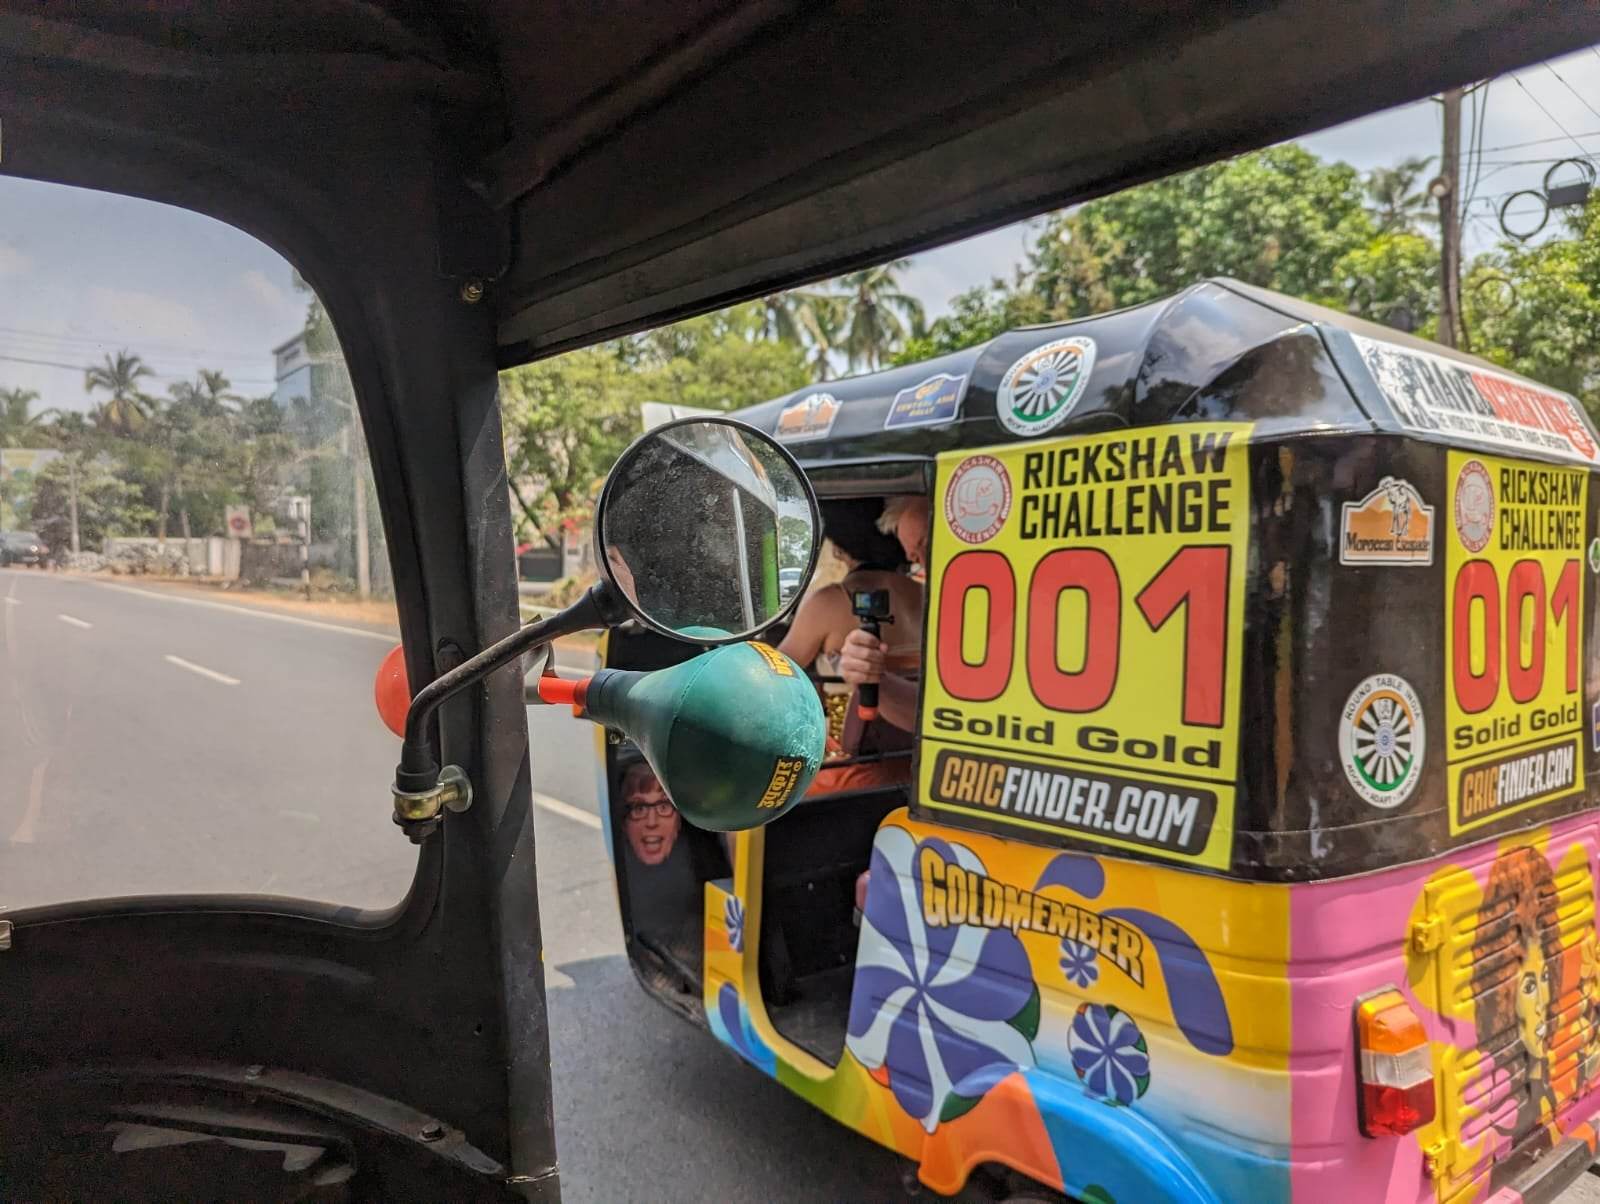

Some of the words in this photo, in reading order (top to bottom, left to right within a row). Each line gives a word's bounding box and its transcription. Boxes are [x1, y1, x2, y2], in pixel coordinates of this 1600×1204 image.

[1023, 432, 1234, 490] RICKSHAW
[1500, 468, 1584, 506] RICKSHAW
[1020, 479, 1232, 540] CHALLENGE
[1500, 508, 1581, 551] CHALLENGE
[936, 544, 1231, 728] 001
[1452, 558, 1580, 715] 001
[1344, 683, 1372, 721] ROUND
[1376, 677, 1402, 690] TABLE
[1454, 712, 1521, 750] Solid
[1530, 702, 1578, 731] Gold
[933, 707, 1055, 745] Solid
[1077, 726, 1221, 769] Gold
[939, 756, 1200, 847] CRICFINDER.COM
[1462, 745, 1574, 818] CRICFINDER.COM
[920, 847, 1144, 989] GOLDMEMBER
